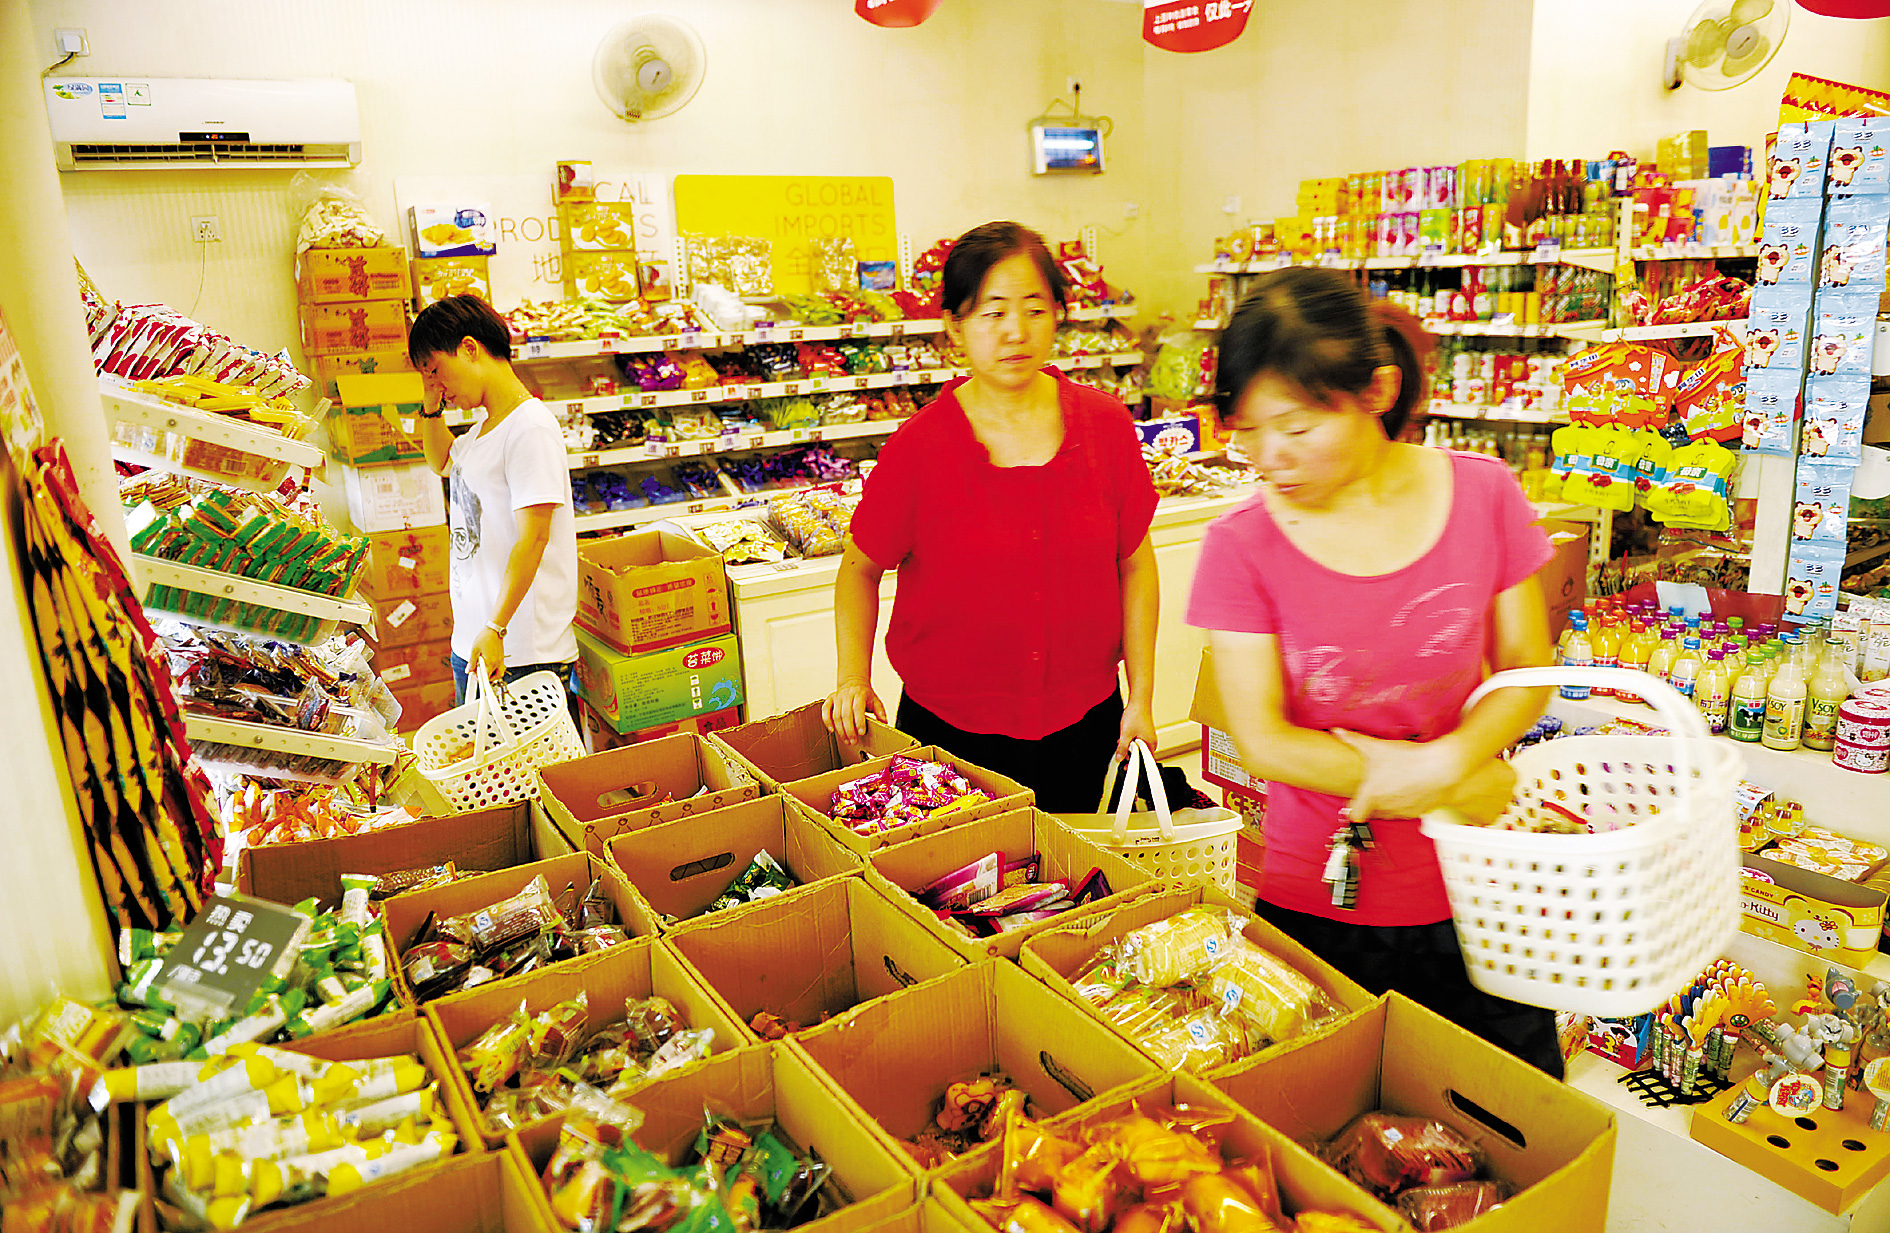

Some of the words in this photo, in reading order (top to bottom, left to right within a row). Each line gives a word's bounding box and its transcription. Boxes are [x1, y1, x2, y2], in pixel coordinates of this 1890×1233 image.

[551, 182, 652, 207] LCAL
[786, 182, 883, 207] GLOBAL
[774, 213, 886, 237] IMPORTS
[1750, 887, 1774, 898] CANDY
[1750, 901, 1779, 921] Kitty
